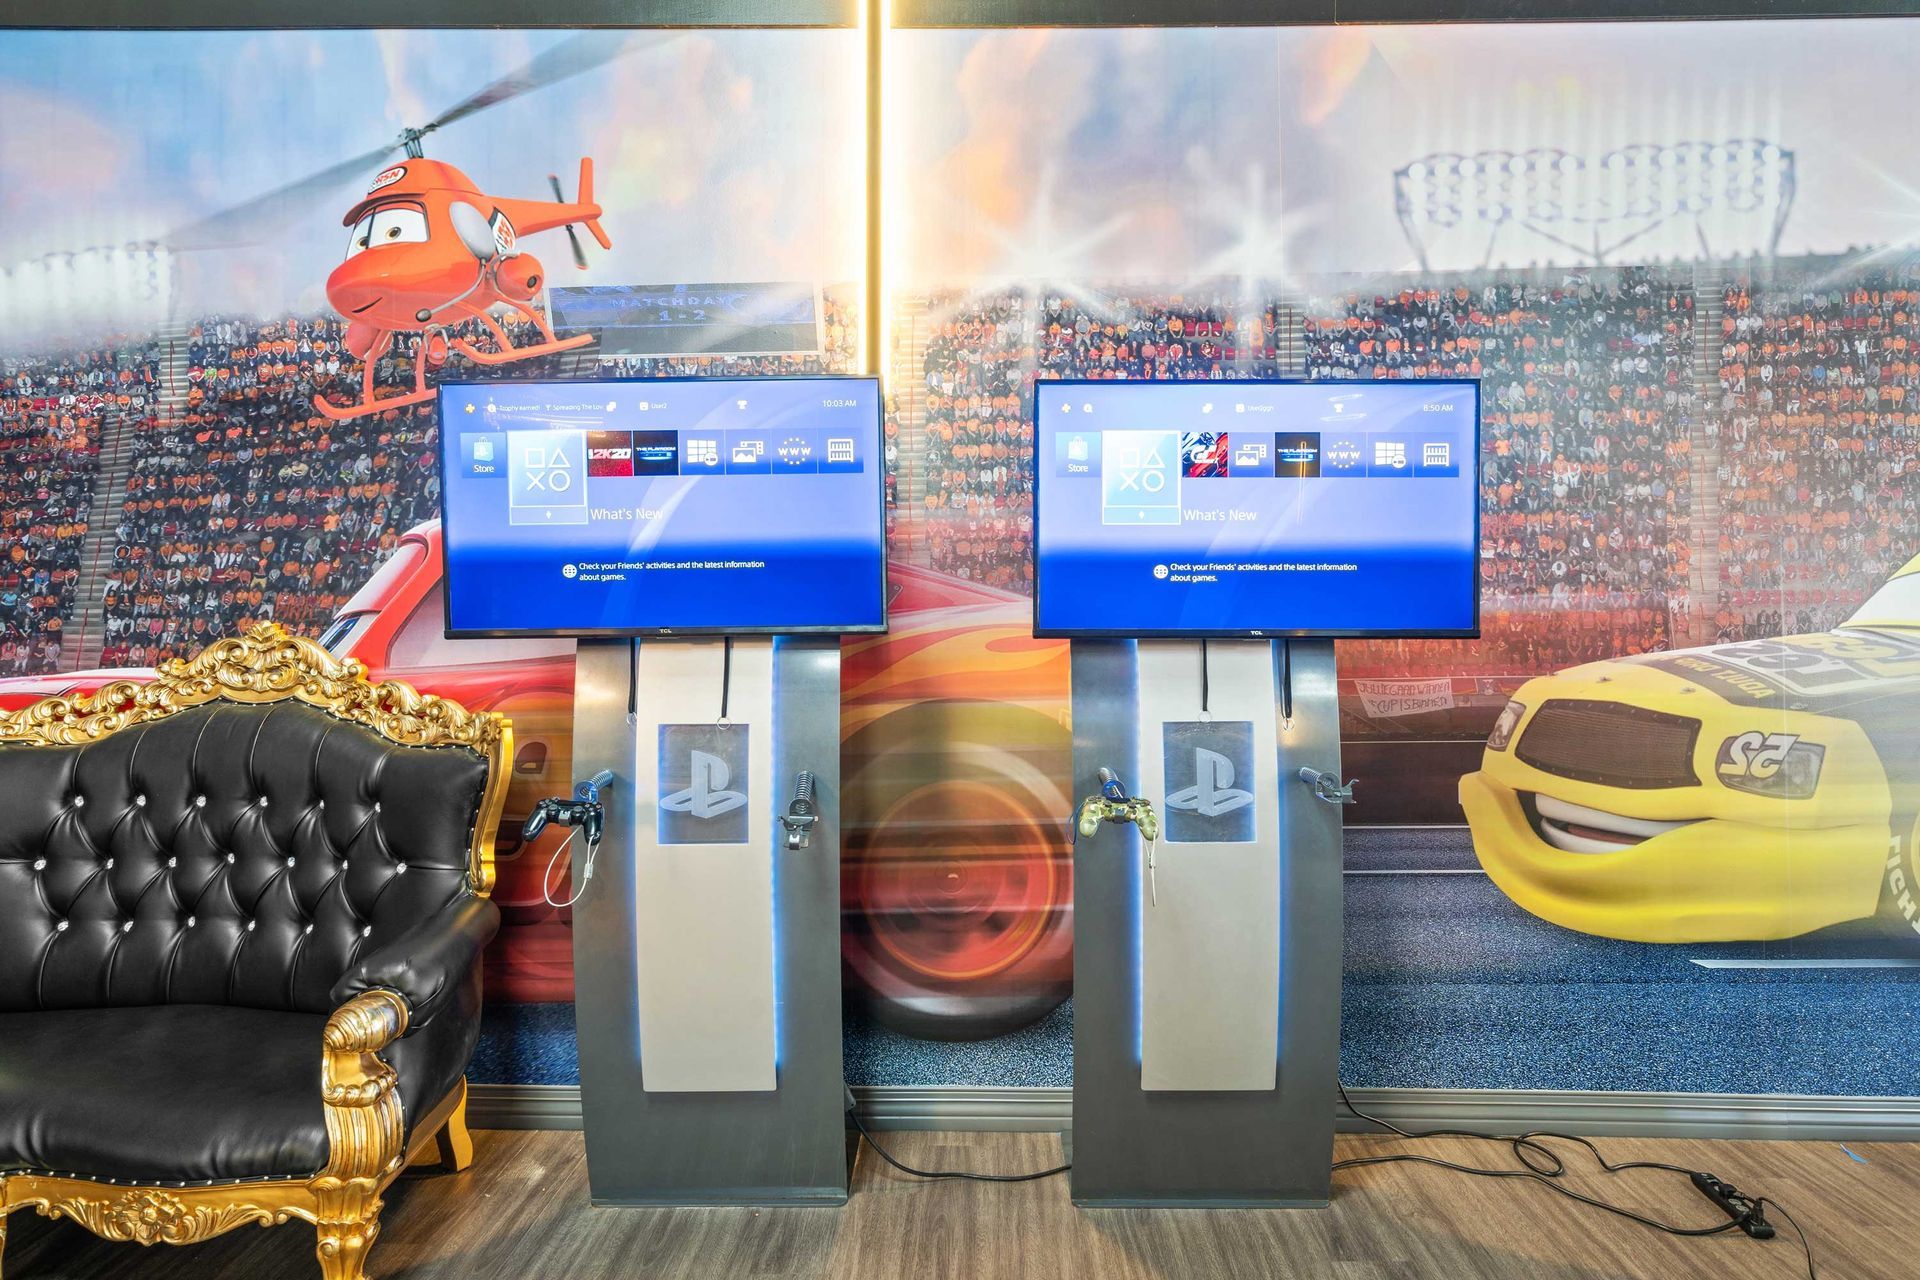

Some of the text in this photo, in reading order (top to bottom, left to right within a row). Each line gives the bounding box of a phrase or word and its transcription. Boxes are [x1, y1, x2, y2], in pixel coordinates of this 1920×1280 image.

[823, 400, 857, 408] 10:03 AM
[1441, 404, 1454, 412] AM
[474, 464, 495, 473] Store
[1068, 464, 1089, 473] Store
[590, 508, 664, 520] What's New
[1183, 509, 1257, 521] What's New
[579, 560, 765, 572] Check your Friends' activities and the latest information
[1170, 563, 1358, 573] Check your Friends' activities and the latest information
[579, 573, 627, 583] about games.
[1170, 574, 1218, 584] about games.
